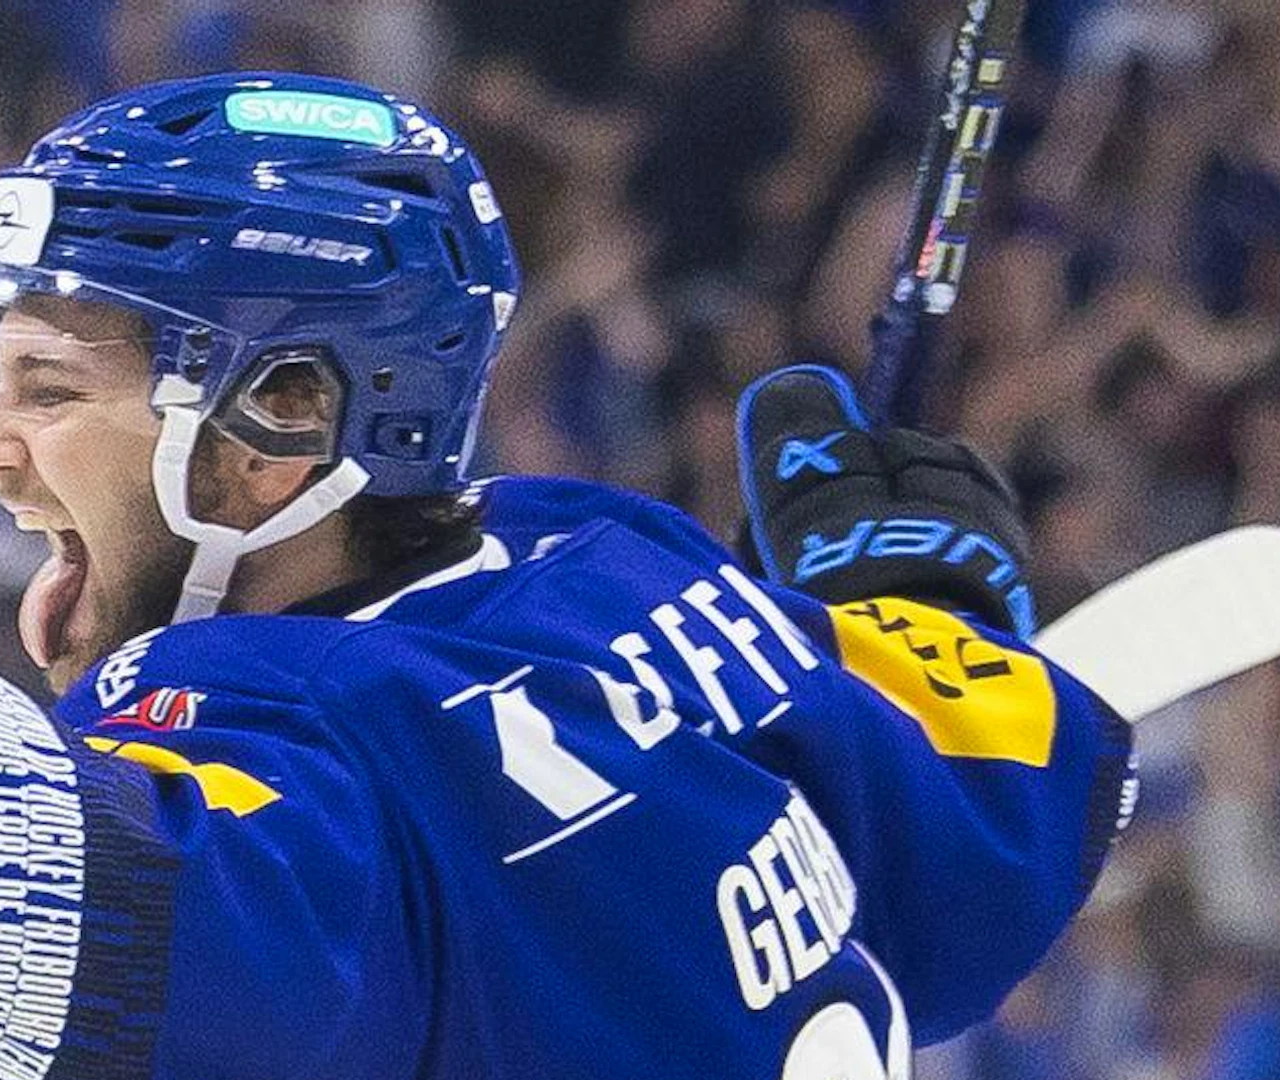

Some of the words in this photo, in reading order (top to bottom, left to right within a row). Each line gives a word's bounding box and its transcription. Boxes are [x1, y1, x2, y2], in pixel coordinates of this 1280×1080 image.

[239, 98, 383, 135] SWICA
[24, 782, 85, 901] HOCKEY
[4, 904, 83, 1050] FRIBOURG
